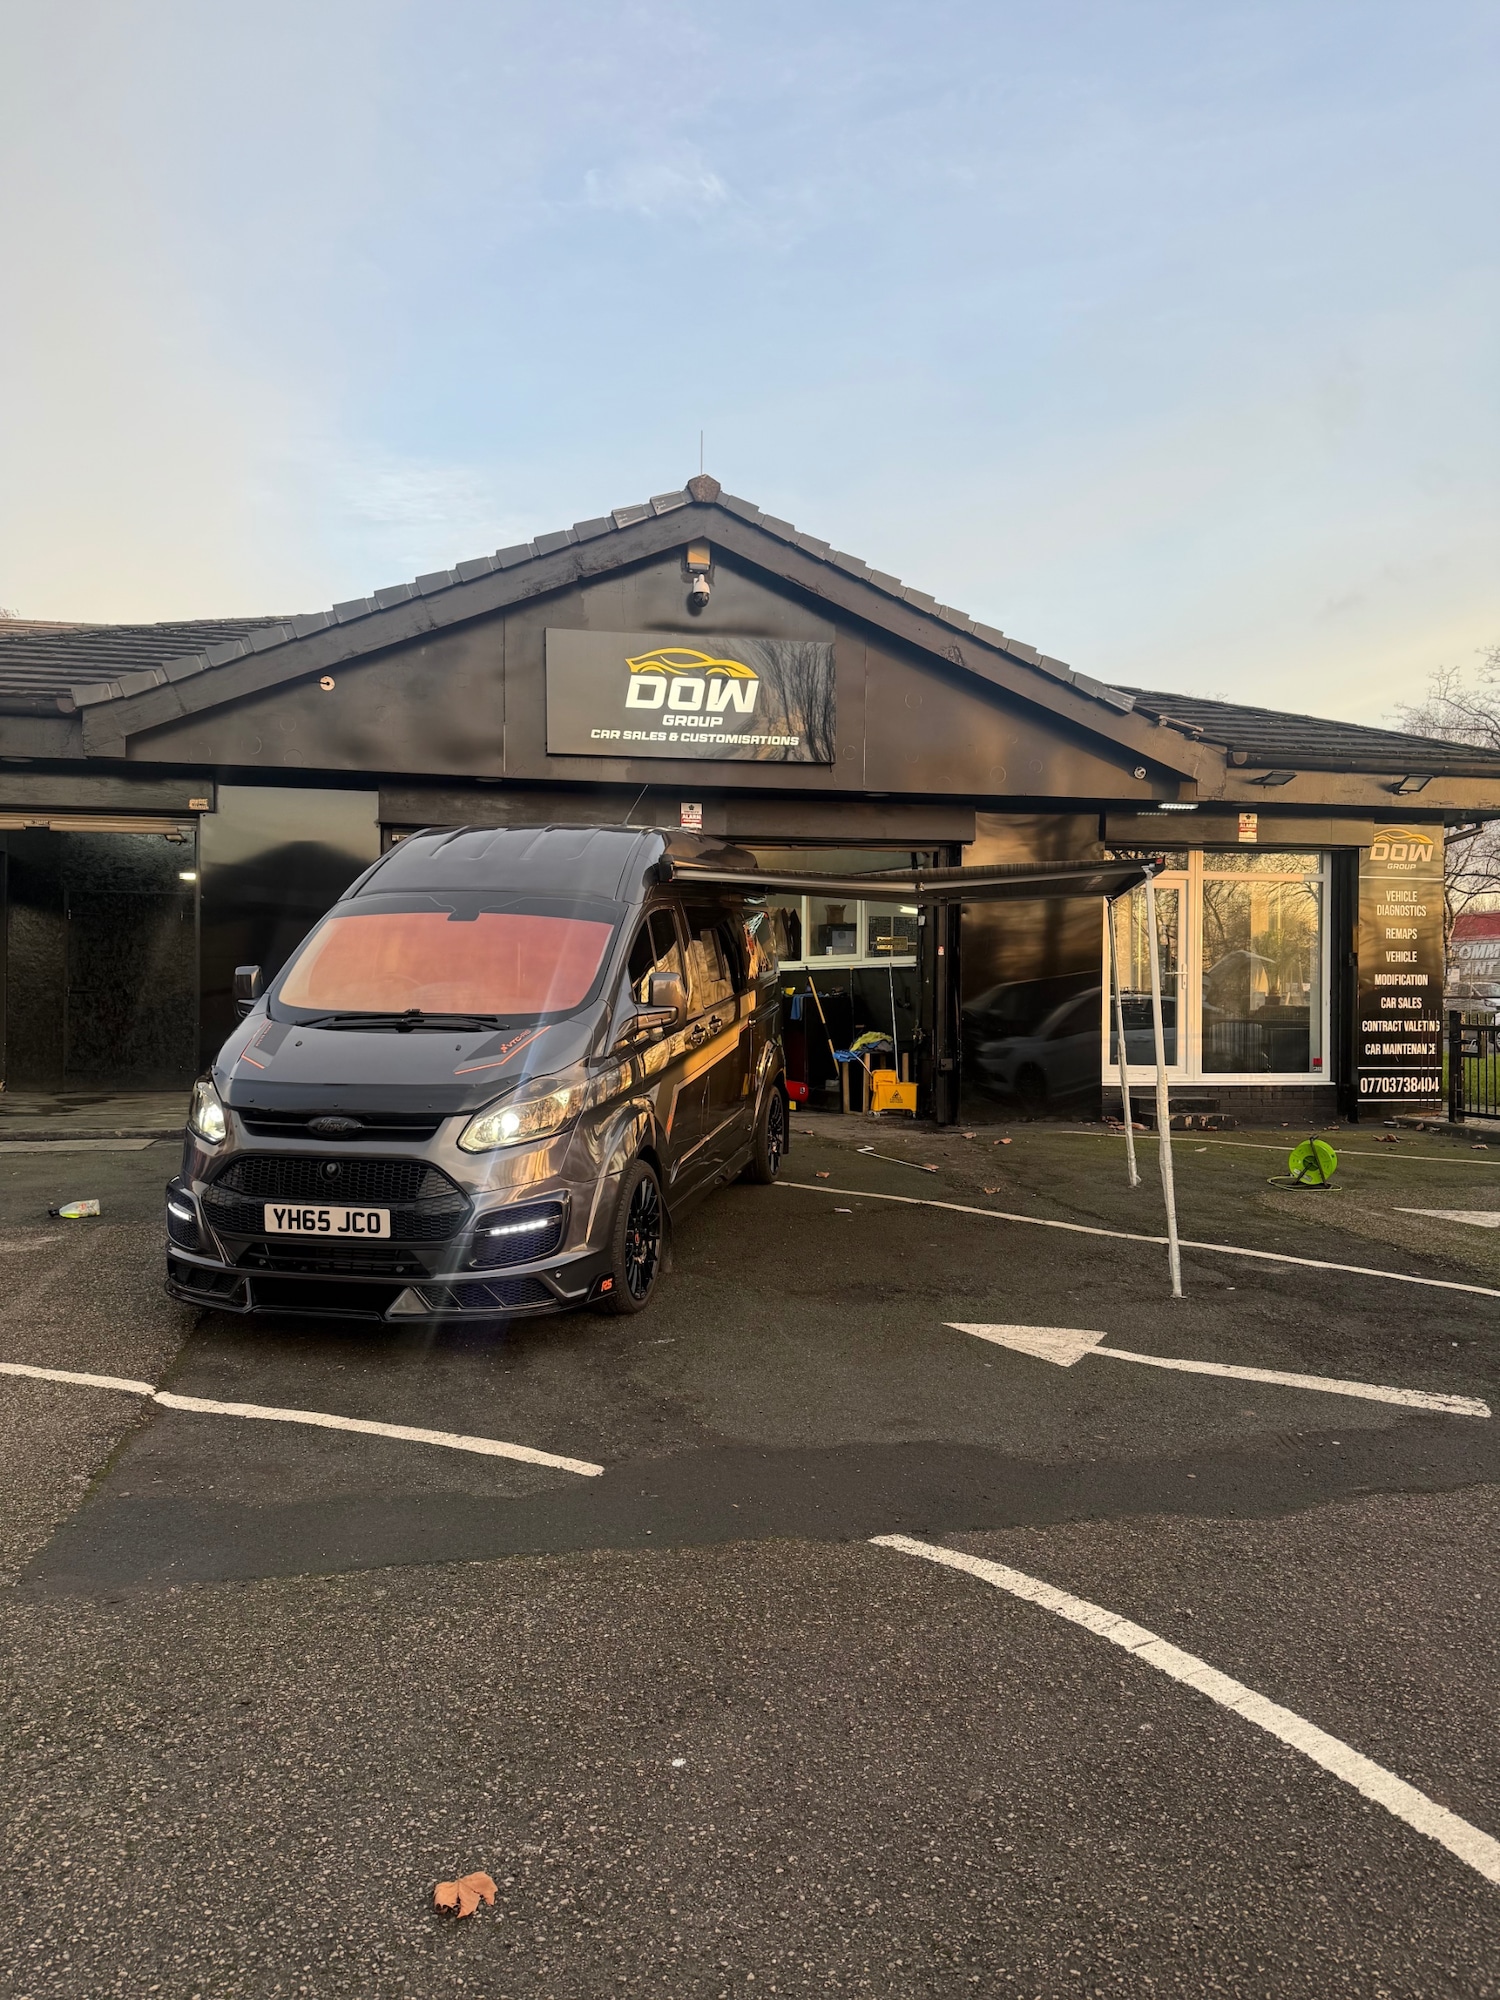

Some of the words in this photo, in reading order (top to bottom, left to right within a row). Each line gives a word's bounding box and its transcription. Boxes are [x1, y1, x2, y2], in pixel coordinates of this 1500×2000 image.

[625, 674, 760, 713] DOW
[662, 714, 723, 727] GROUP
[590, 729, 621, 739] CAR
[622, 730, 667, 741] SALES
[668, 732, 679, 741] &
[680, 732, 800, 746] CUSTOMISATIONS
[1369, 843, 1434, 862] DOW
[1385, 890, 1418, 902] VEHICLE
[1376, 904, 1427, 917] DIAGNOSTICS
[1385, 928, 1418, 940] REMAPS
[1385, 951, 1418, 963] VEHICLE
[1374, 974, 1429, 986] MODIFICATION
[1380, 997, 1397, 1009] CAR
[1397, 997, 1422, 1009] SALES
[1361, 1020, 1403, 1032] CONTRACT
[1364, 1043, 1382, 1055] CAR
[1360, 1077, 1440, 1093] 07703738404
[273, 1208, 331, 1232] YH65
[337, 1211, 381, 1234] JCO
